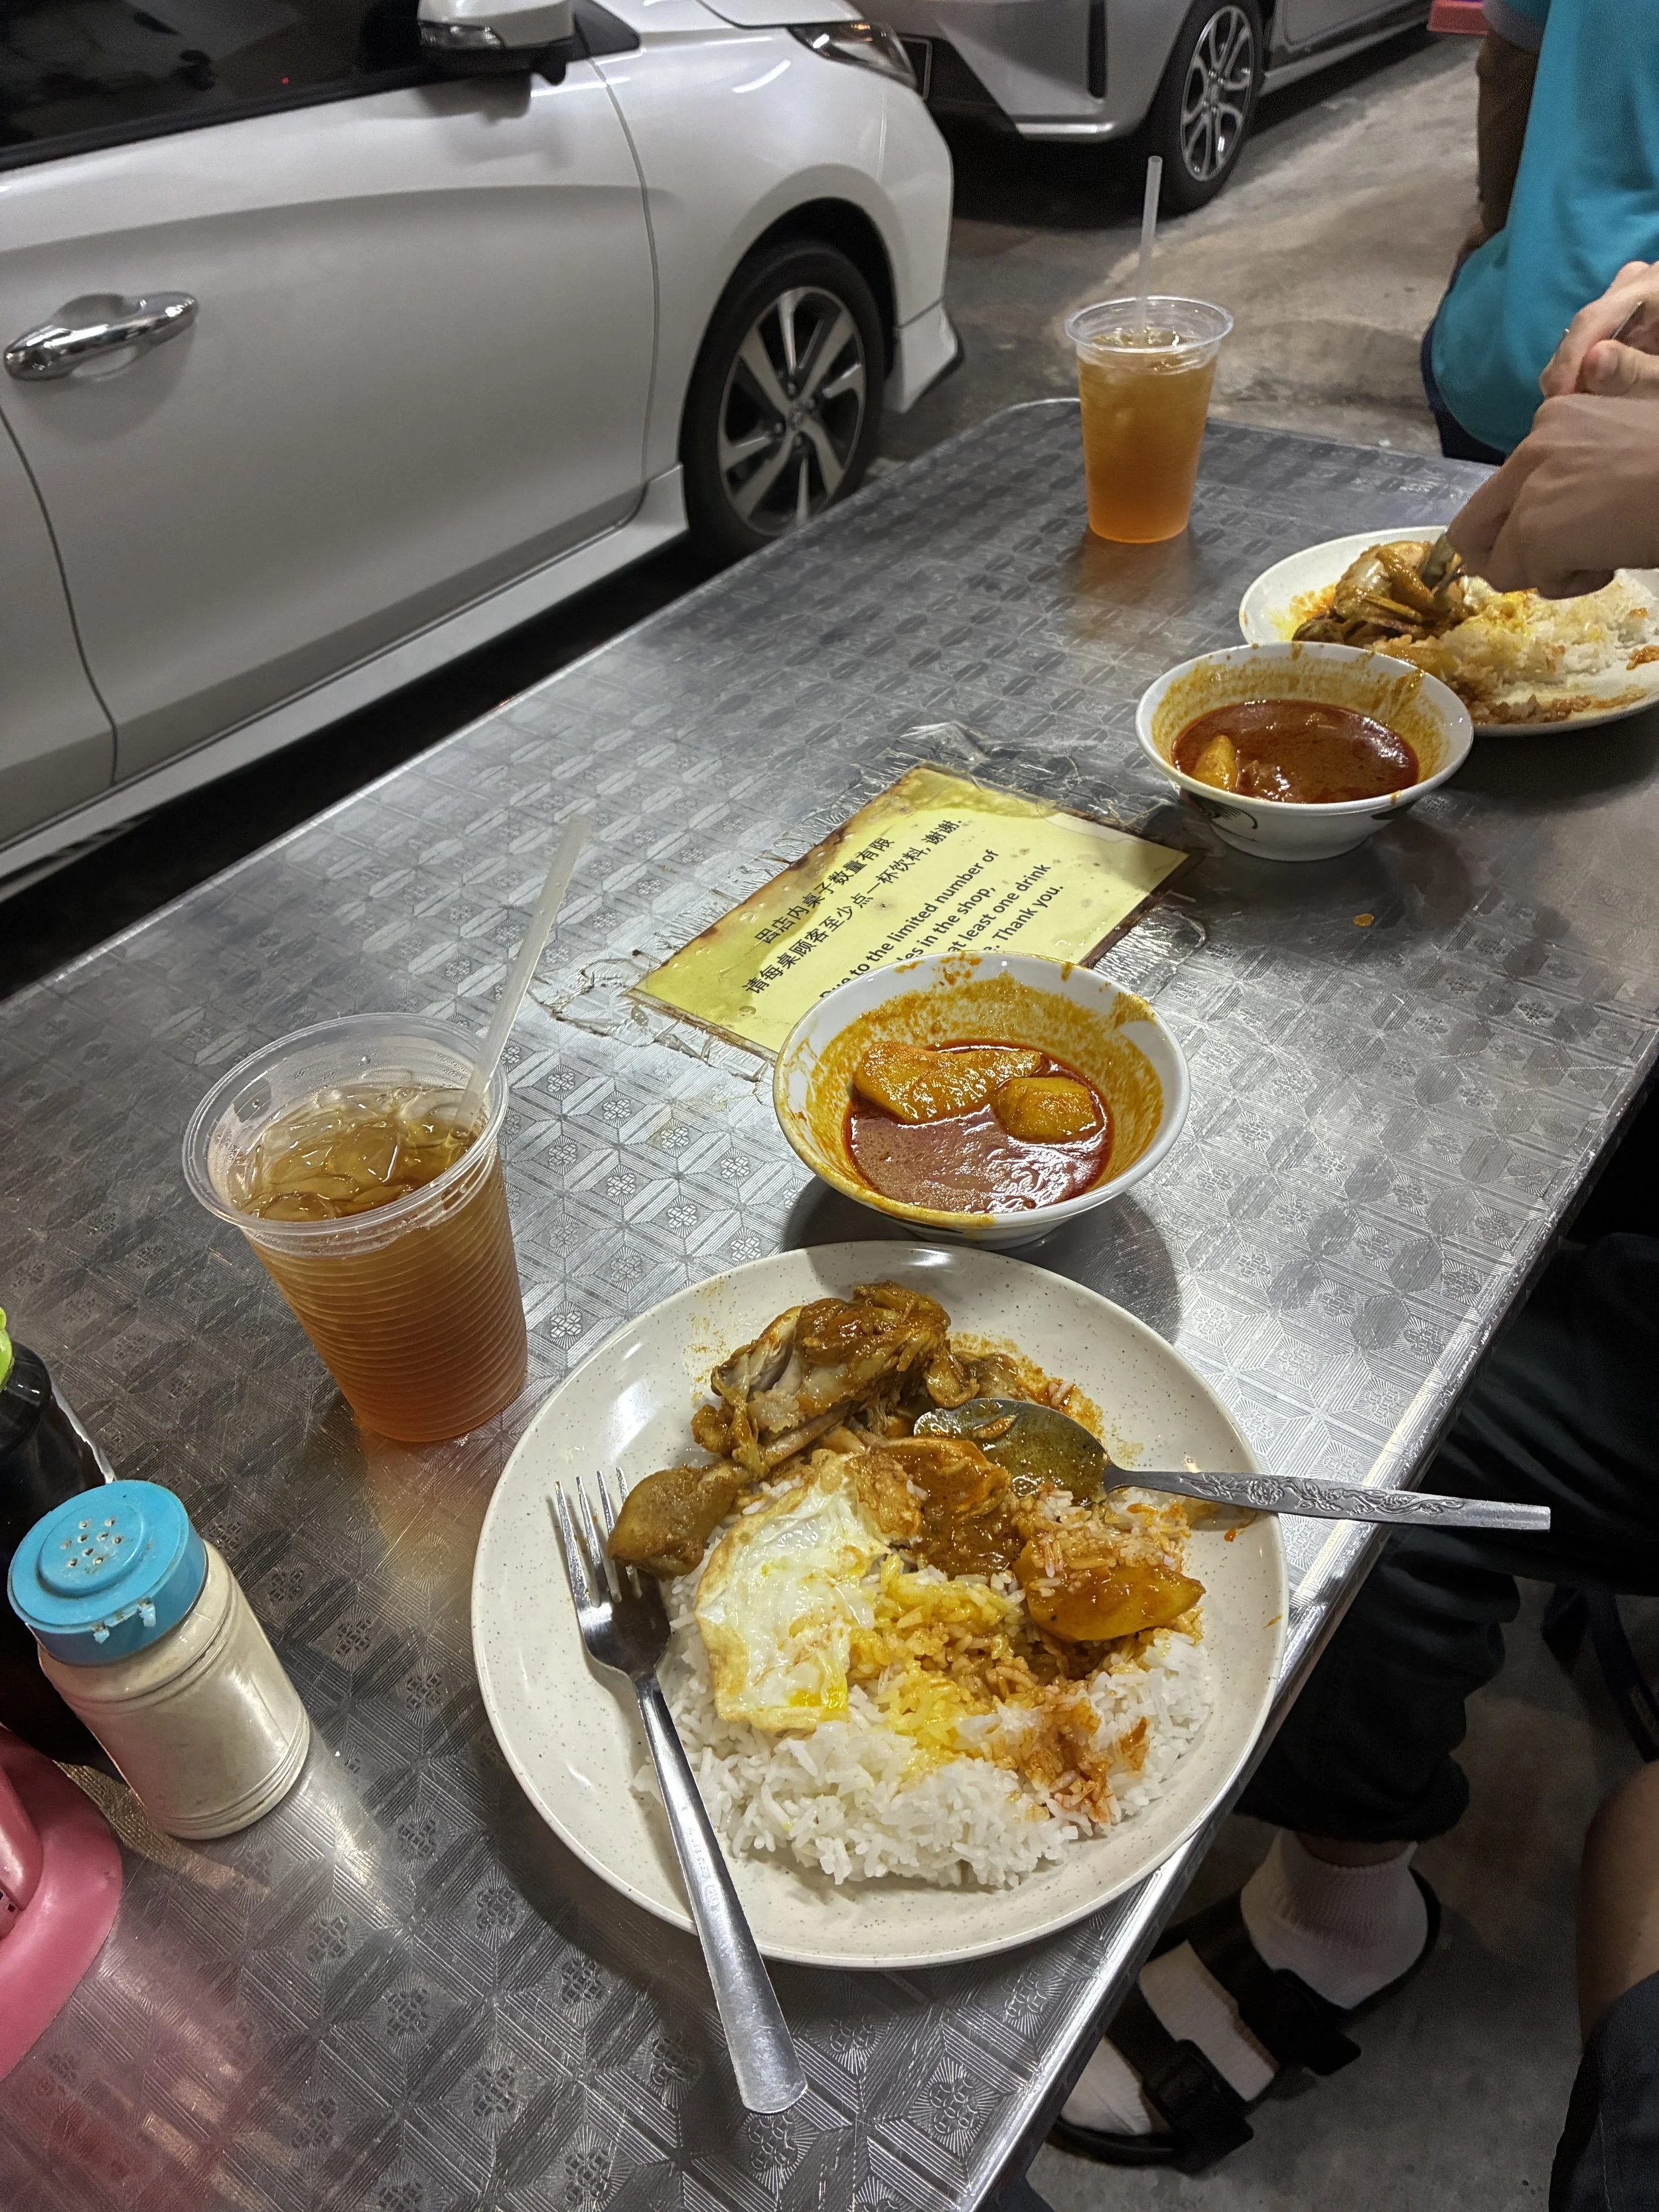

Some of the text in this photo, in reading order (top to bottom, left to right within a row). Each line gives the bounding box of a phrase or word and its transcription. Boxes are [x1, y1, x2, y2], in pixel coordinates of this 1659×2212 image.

[754, 837, 895, 944] 因店内桌子数量有限
[849, 849, 999, 976] to the limited number of
[916, 934, 938, 947] in
[932, 915, 960, 934] the
[957, 887, 995, 915] shop,
[948, 864, 1051, 952] at least one drink
[991, 886, 1064, 940] Thank you.
